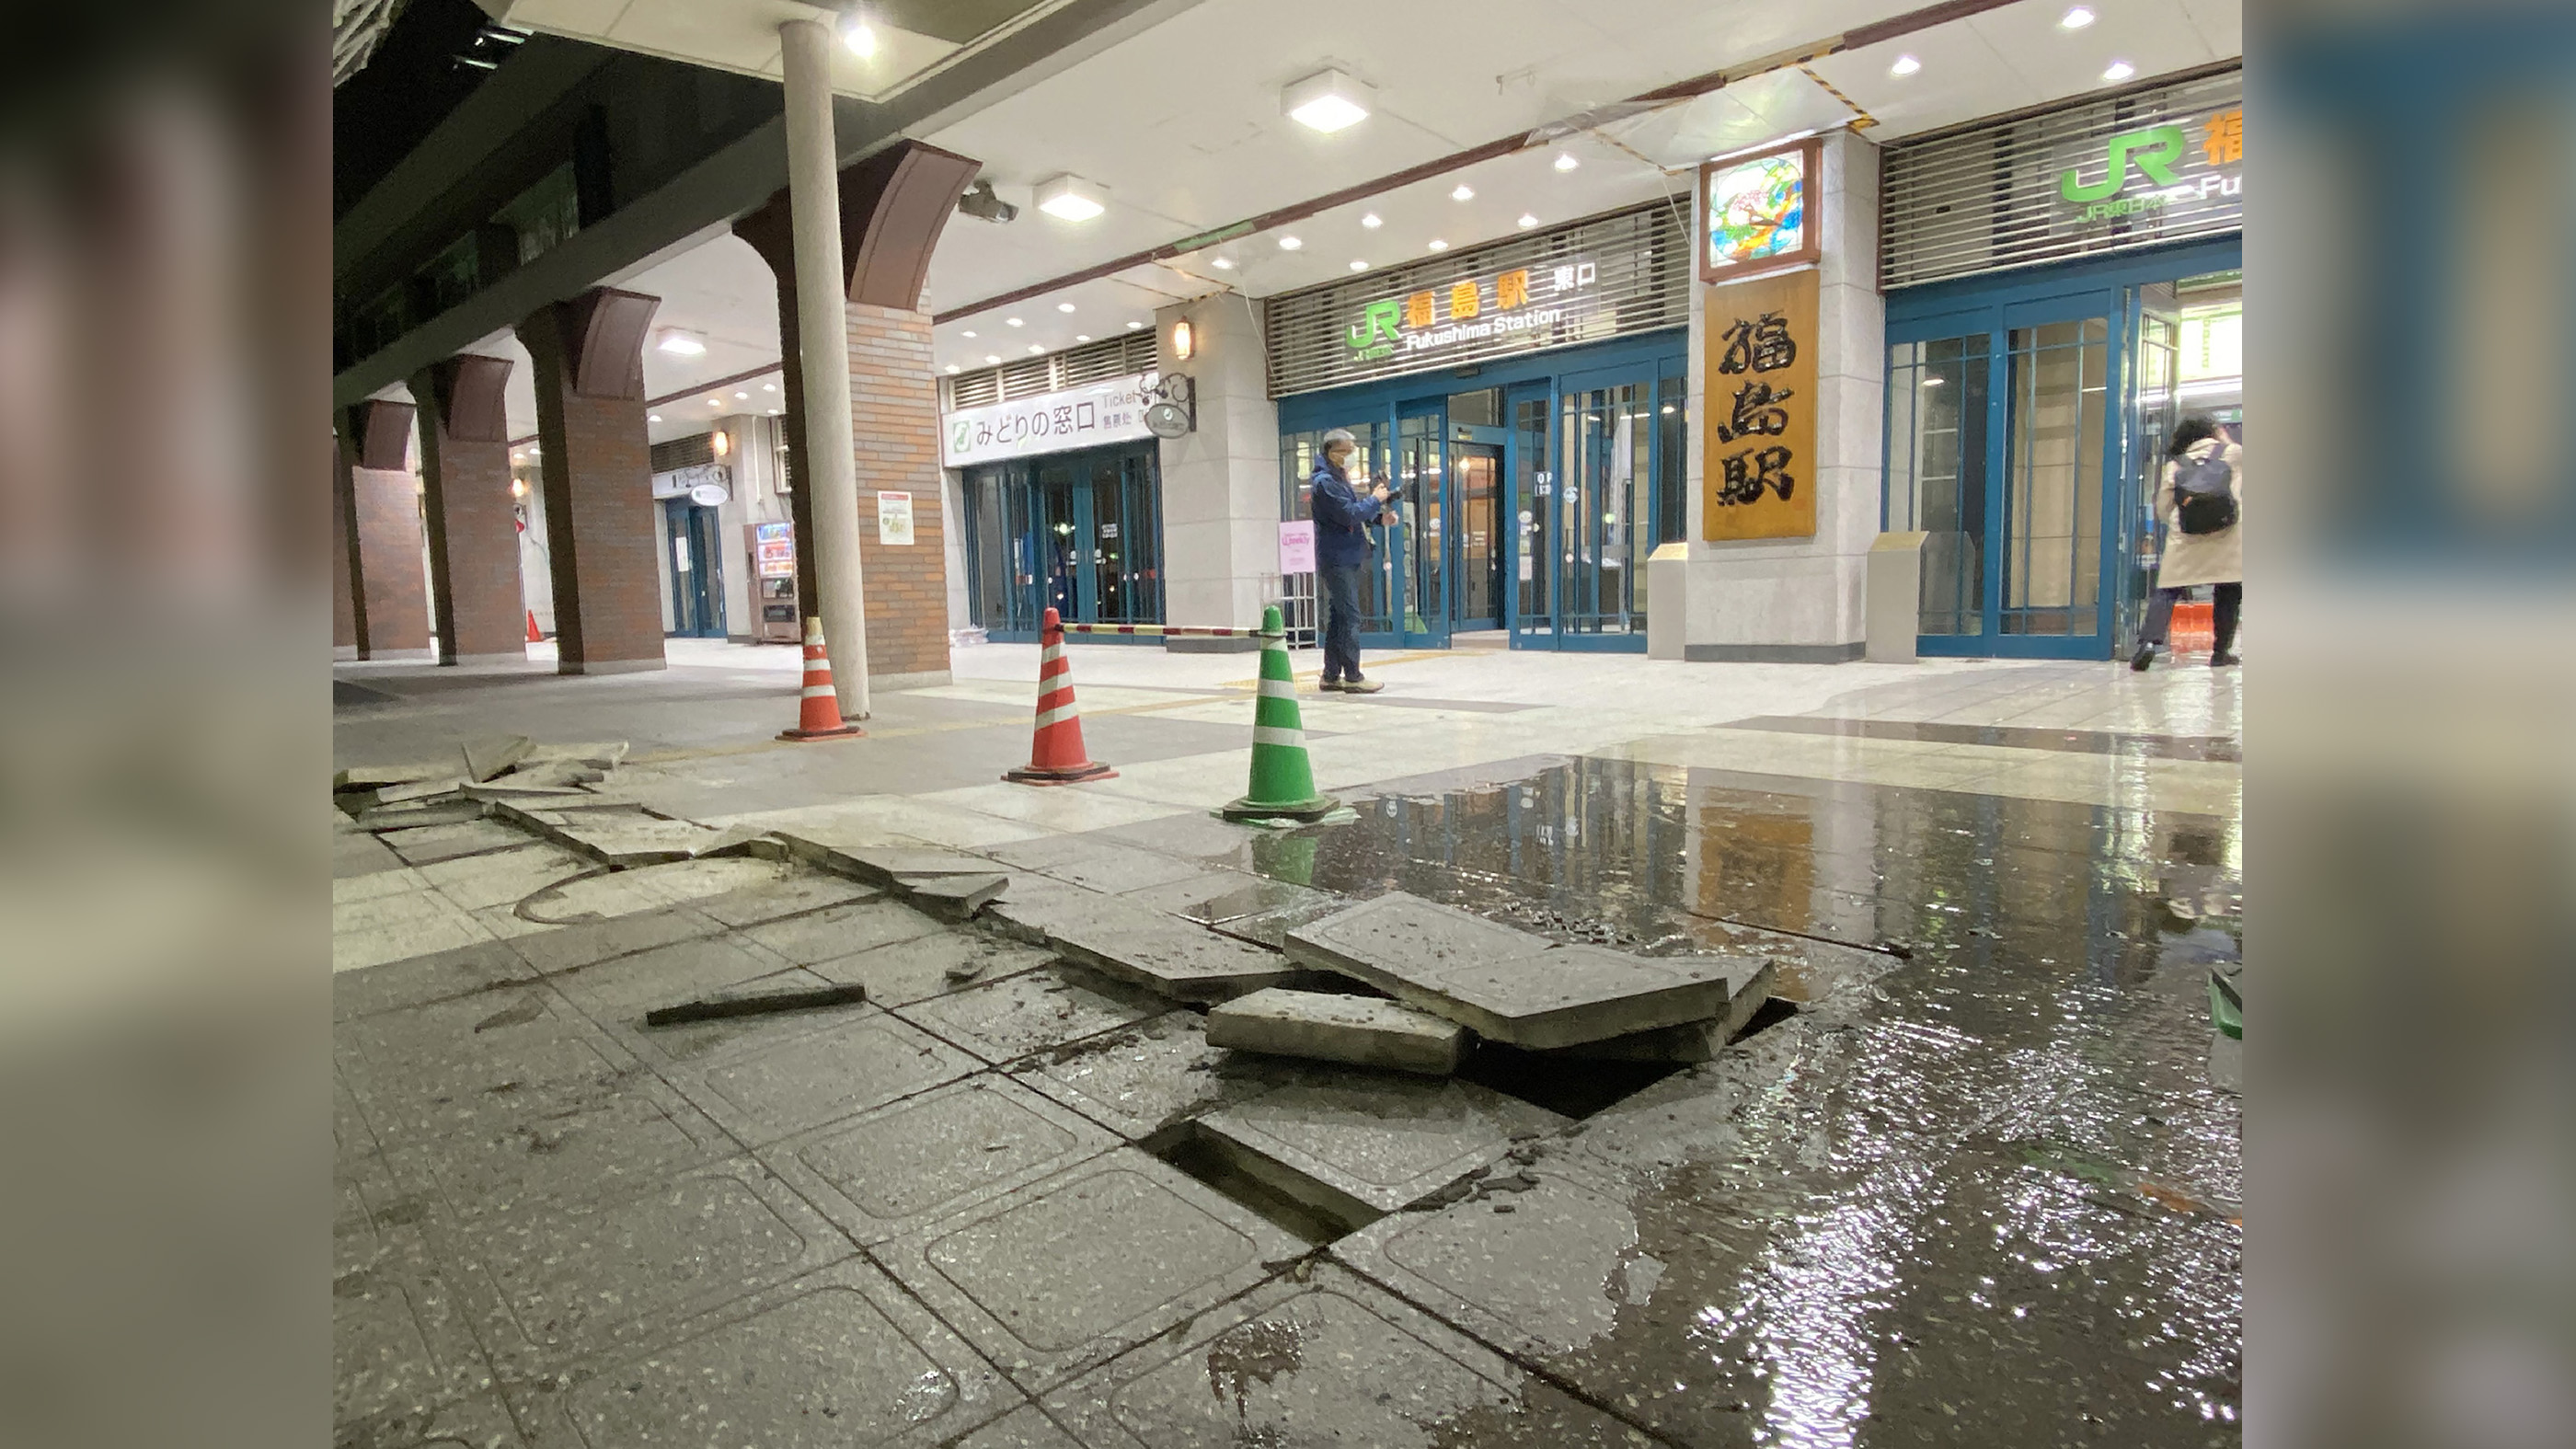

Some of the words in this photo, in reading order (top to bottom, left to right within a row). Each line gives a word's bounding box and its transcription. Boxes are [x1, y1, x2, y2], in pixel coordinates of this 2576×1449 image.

[2061, 124, 2183, 201] JR
[1346, 299, 1401, 348] JR
[1407, 270, 1529, 328] 福島駅
[1554, 261, 1596, 291] 東口
[1407, 322, 1491, 351] Fukushima
[1493, 308, 1561, 333] Station
[976, 401, 1096, 446] みどりの窓口
[1102, 390, 1137, 408] Ticket
[1718, 309, 1797, 507] 福島駅
